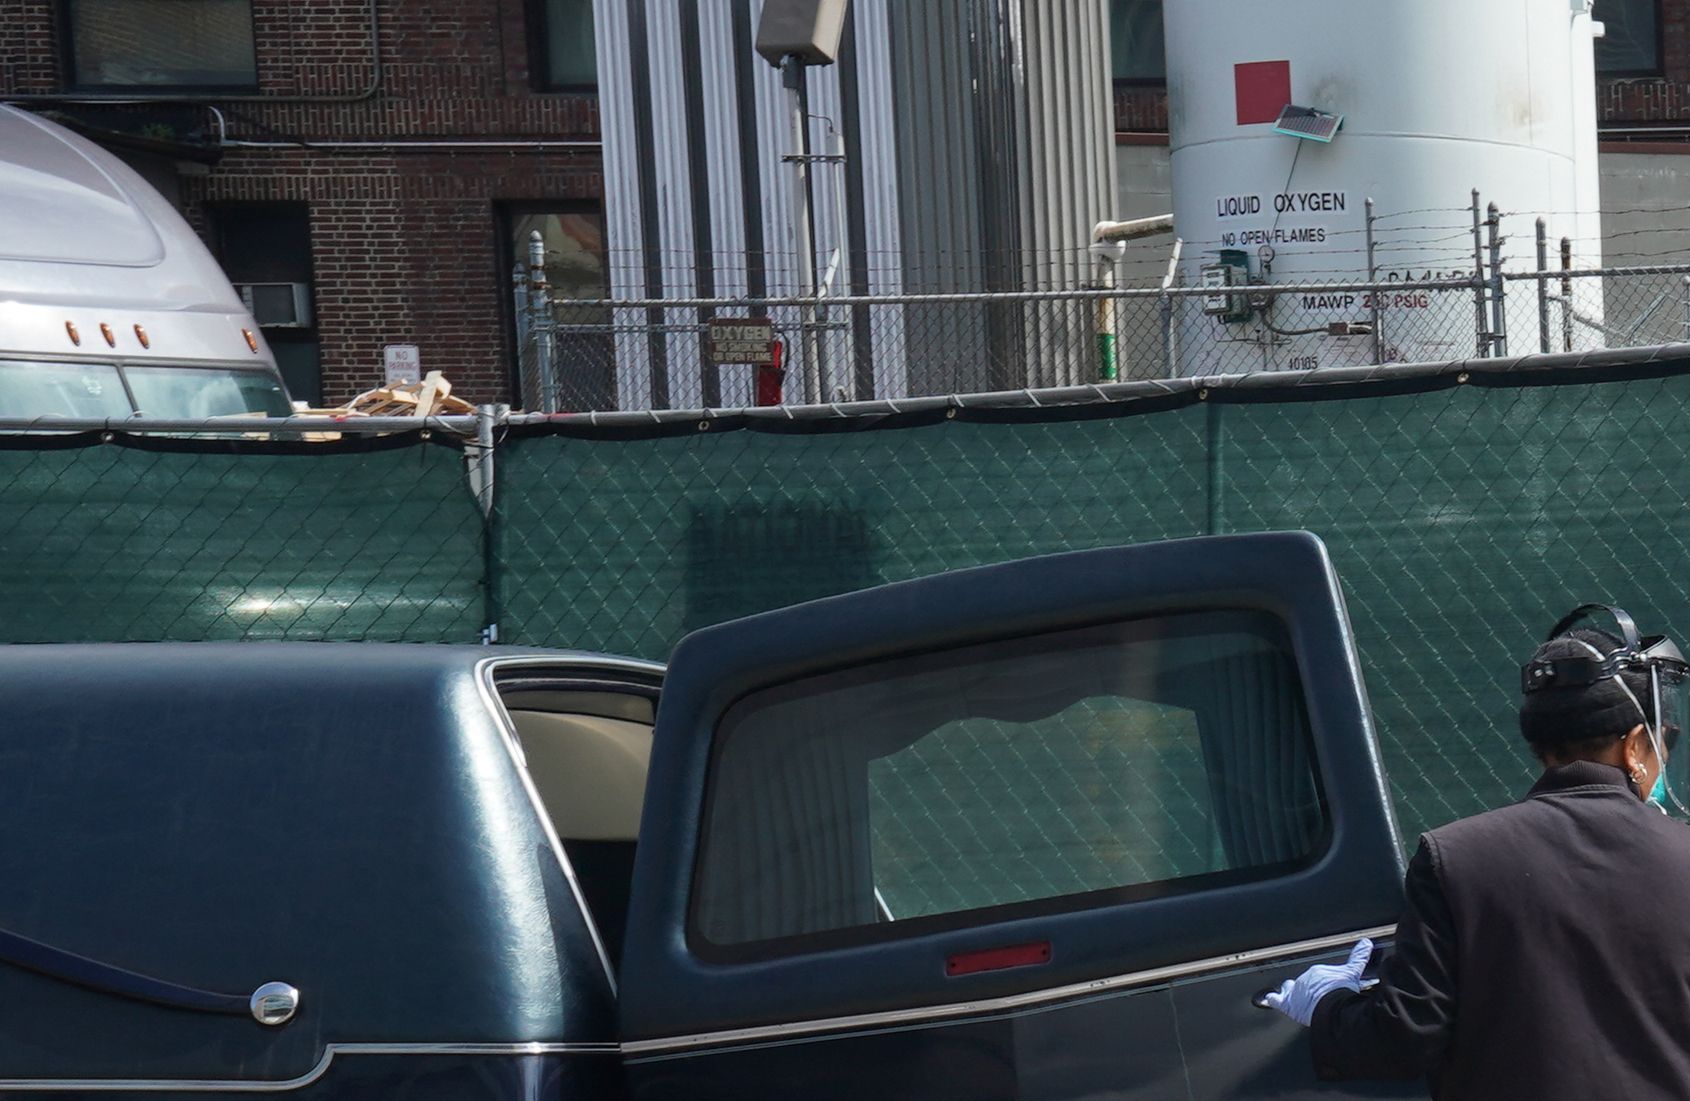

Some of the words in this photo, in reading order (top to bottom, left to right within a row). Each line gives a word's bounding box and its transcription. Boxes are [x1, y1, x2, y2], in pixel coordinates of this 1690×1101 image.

[1217, 195, 1260, 217] LIQUID
[1274, 193, 1345, 213] OXYGEN
[1222, 232, 1235, 247] NO
[1240, 230, 1271, 245] OPEN
[1275, 228, 1325, 243] FLAMES
[1303, 295, 1354, 309] MAWP
[1394, 294, 1429, 309] PSIG
[711, 325, 771, 340] OXYGEN
